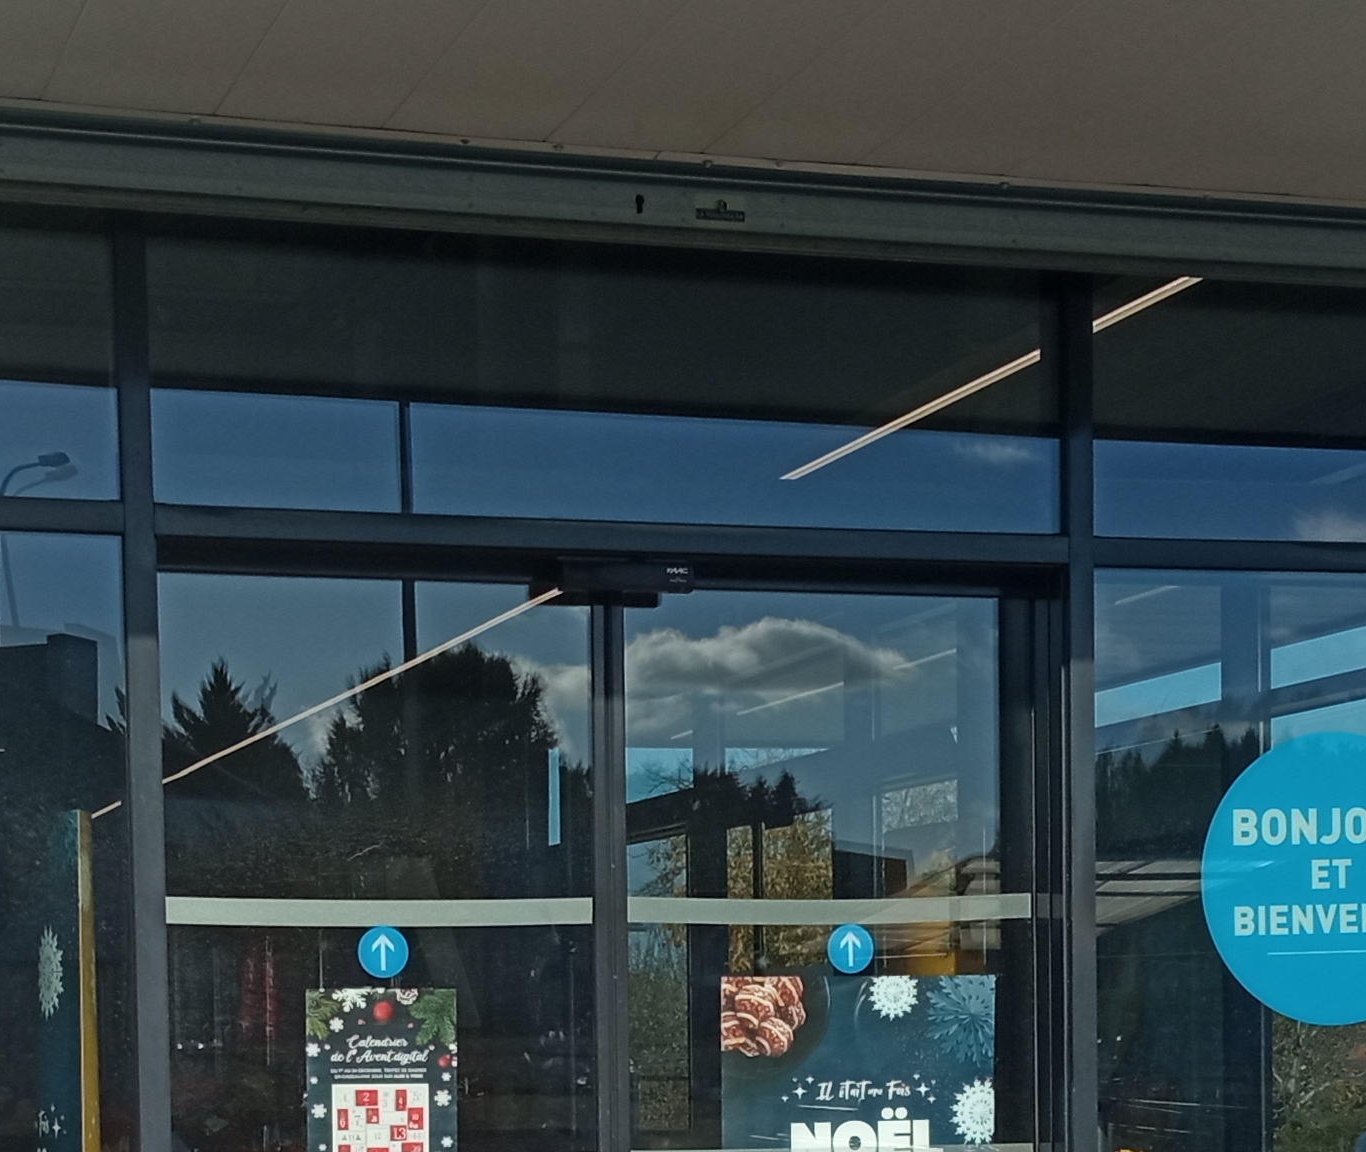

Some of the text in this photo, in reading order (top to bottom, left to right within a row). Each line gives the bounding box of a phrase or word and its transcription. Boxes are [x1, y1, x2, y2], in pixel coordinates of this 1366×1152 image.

[1311, 858, 1352, 889] ET
[346, 1034, 408, 1049] Calendrier
[330, 1051, 345, 1063] de
[392, 1049, 430, 1065] digital
[362, 1091, 371, 1103] 2
[815, 1081, 834, 1101] Il
